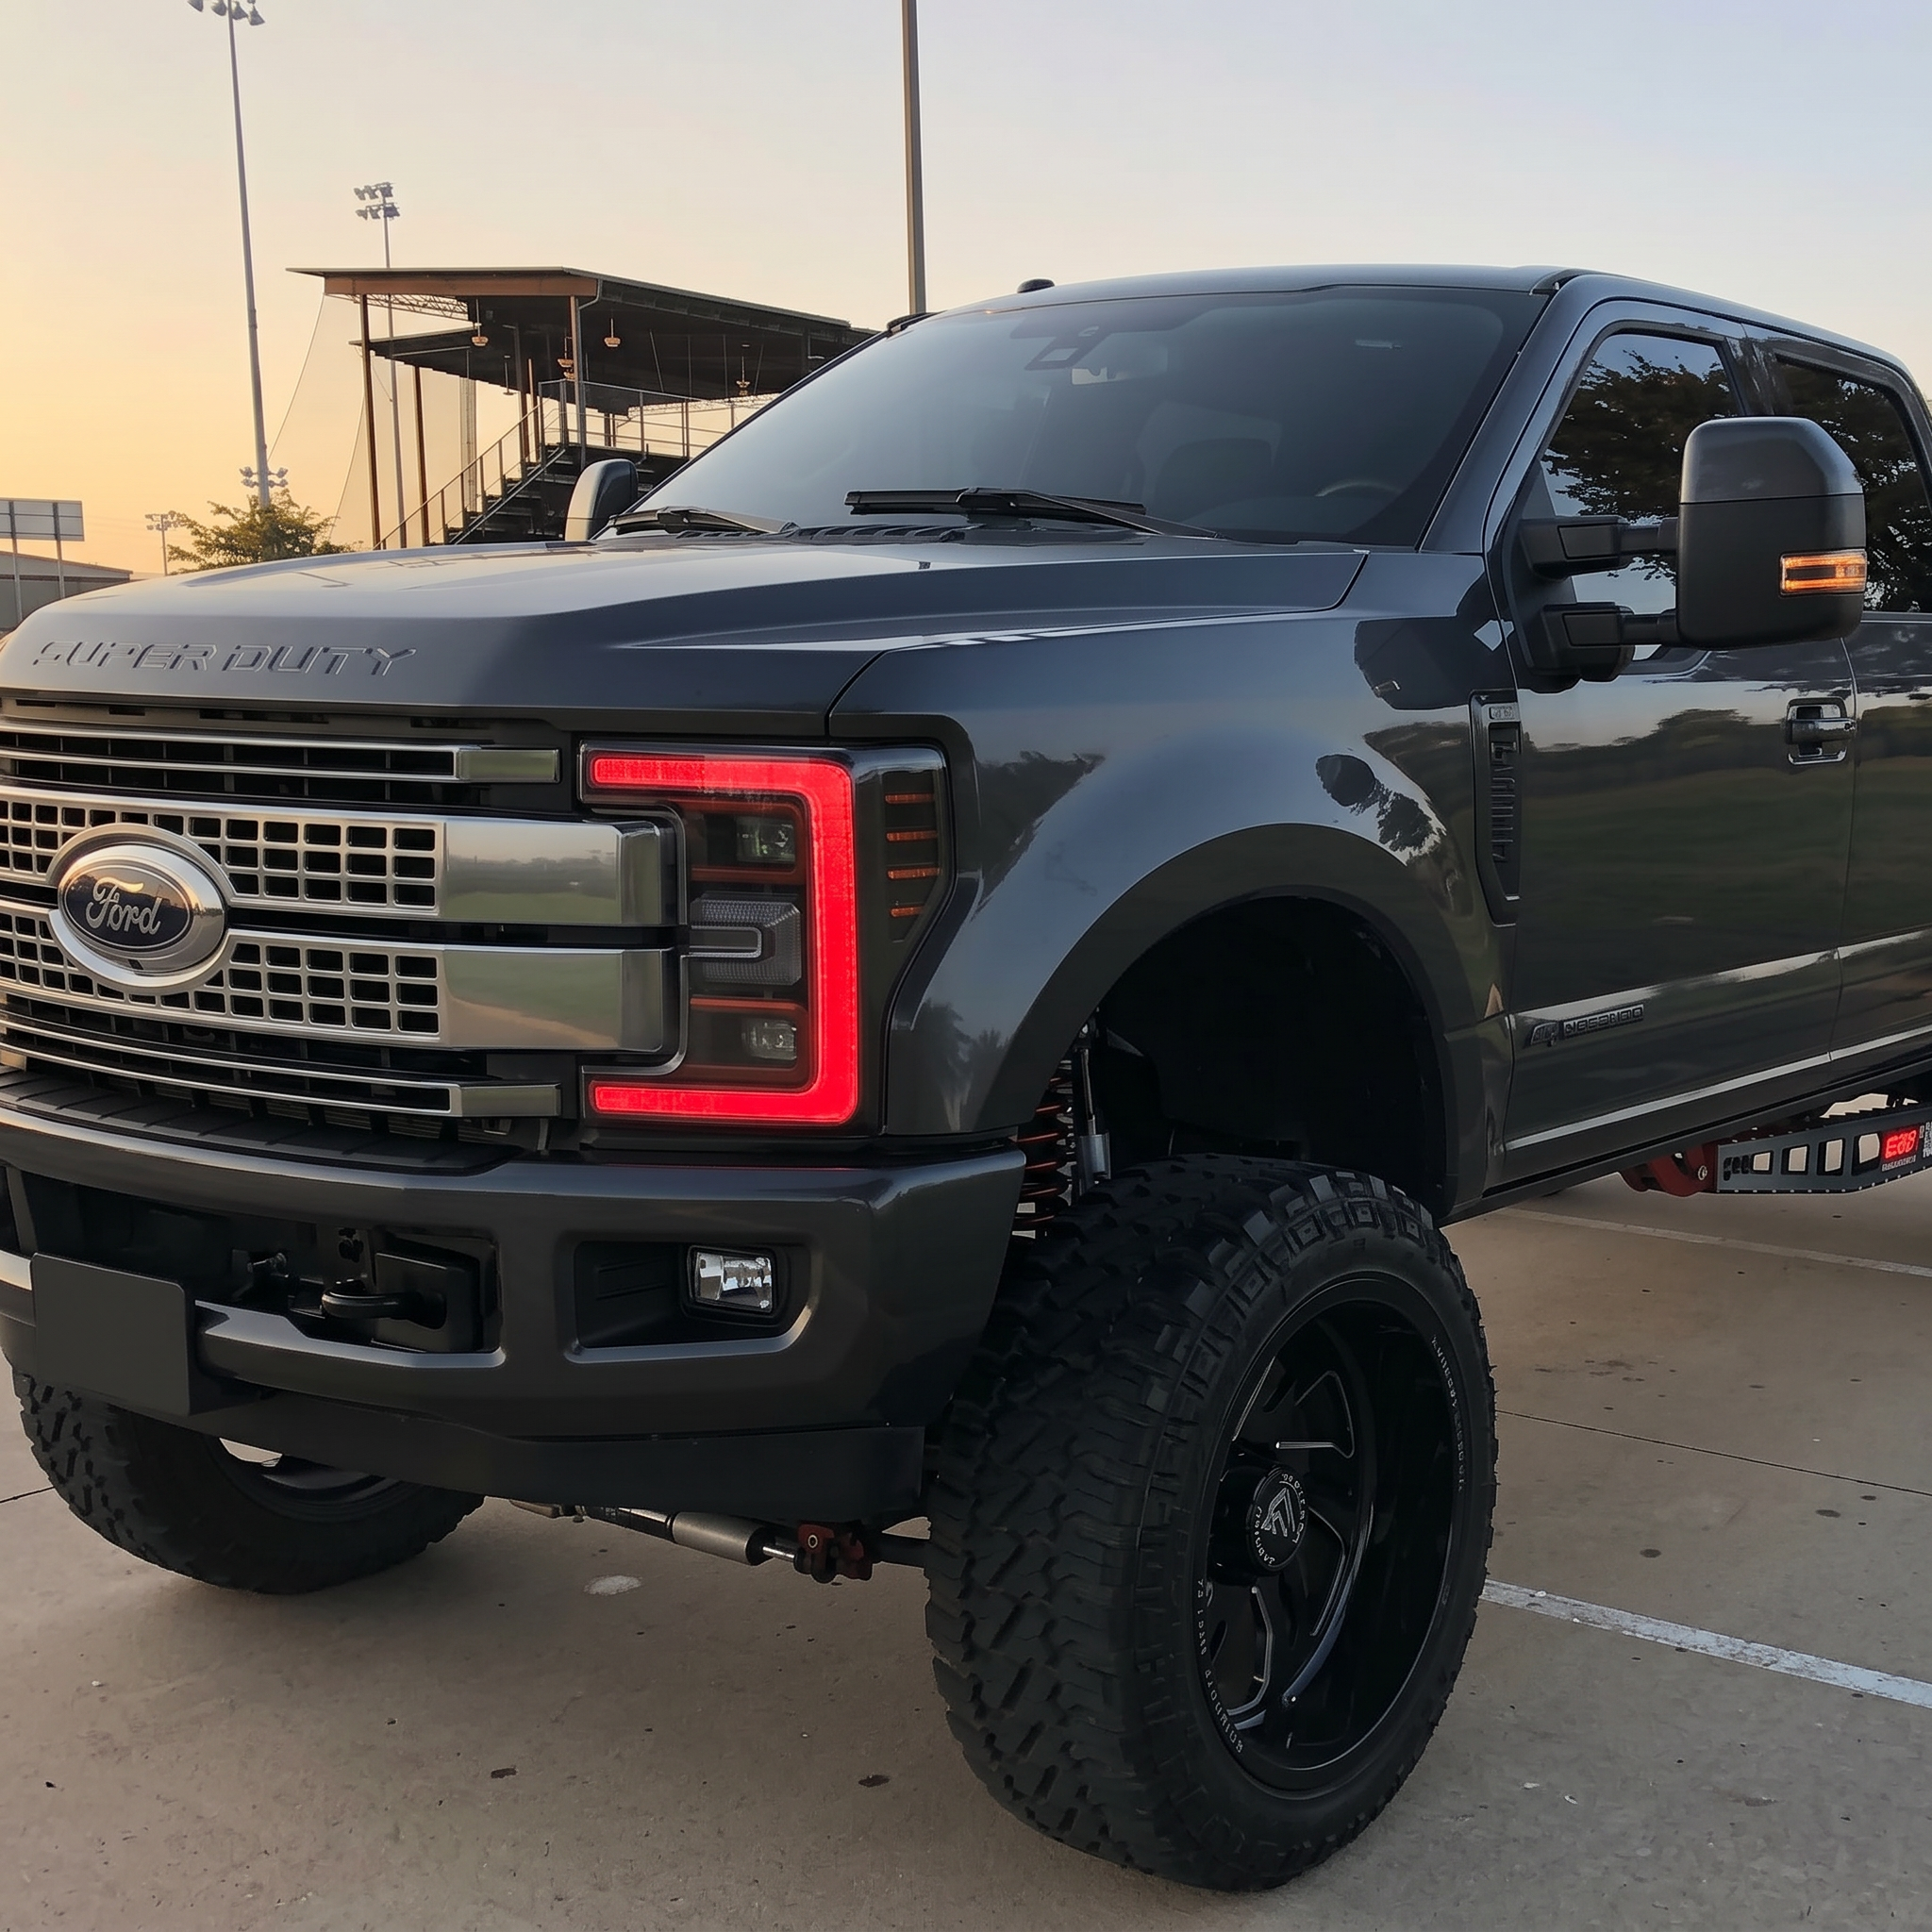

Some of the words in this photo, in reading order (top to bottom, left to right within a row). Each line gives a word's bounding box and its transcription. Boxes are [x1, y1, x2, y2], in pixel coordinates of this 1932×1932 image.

[32, 641, 218, 672] SUPER
[222, 644, 417, 676] DUTY
[86, 876, 163, 935] Ford
